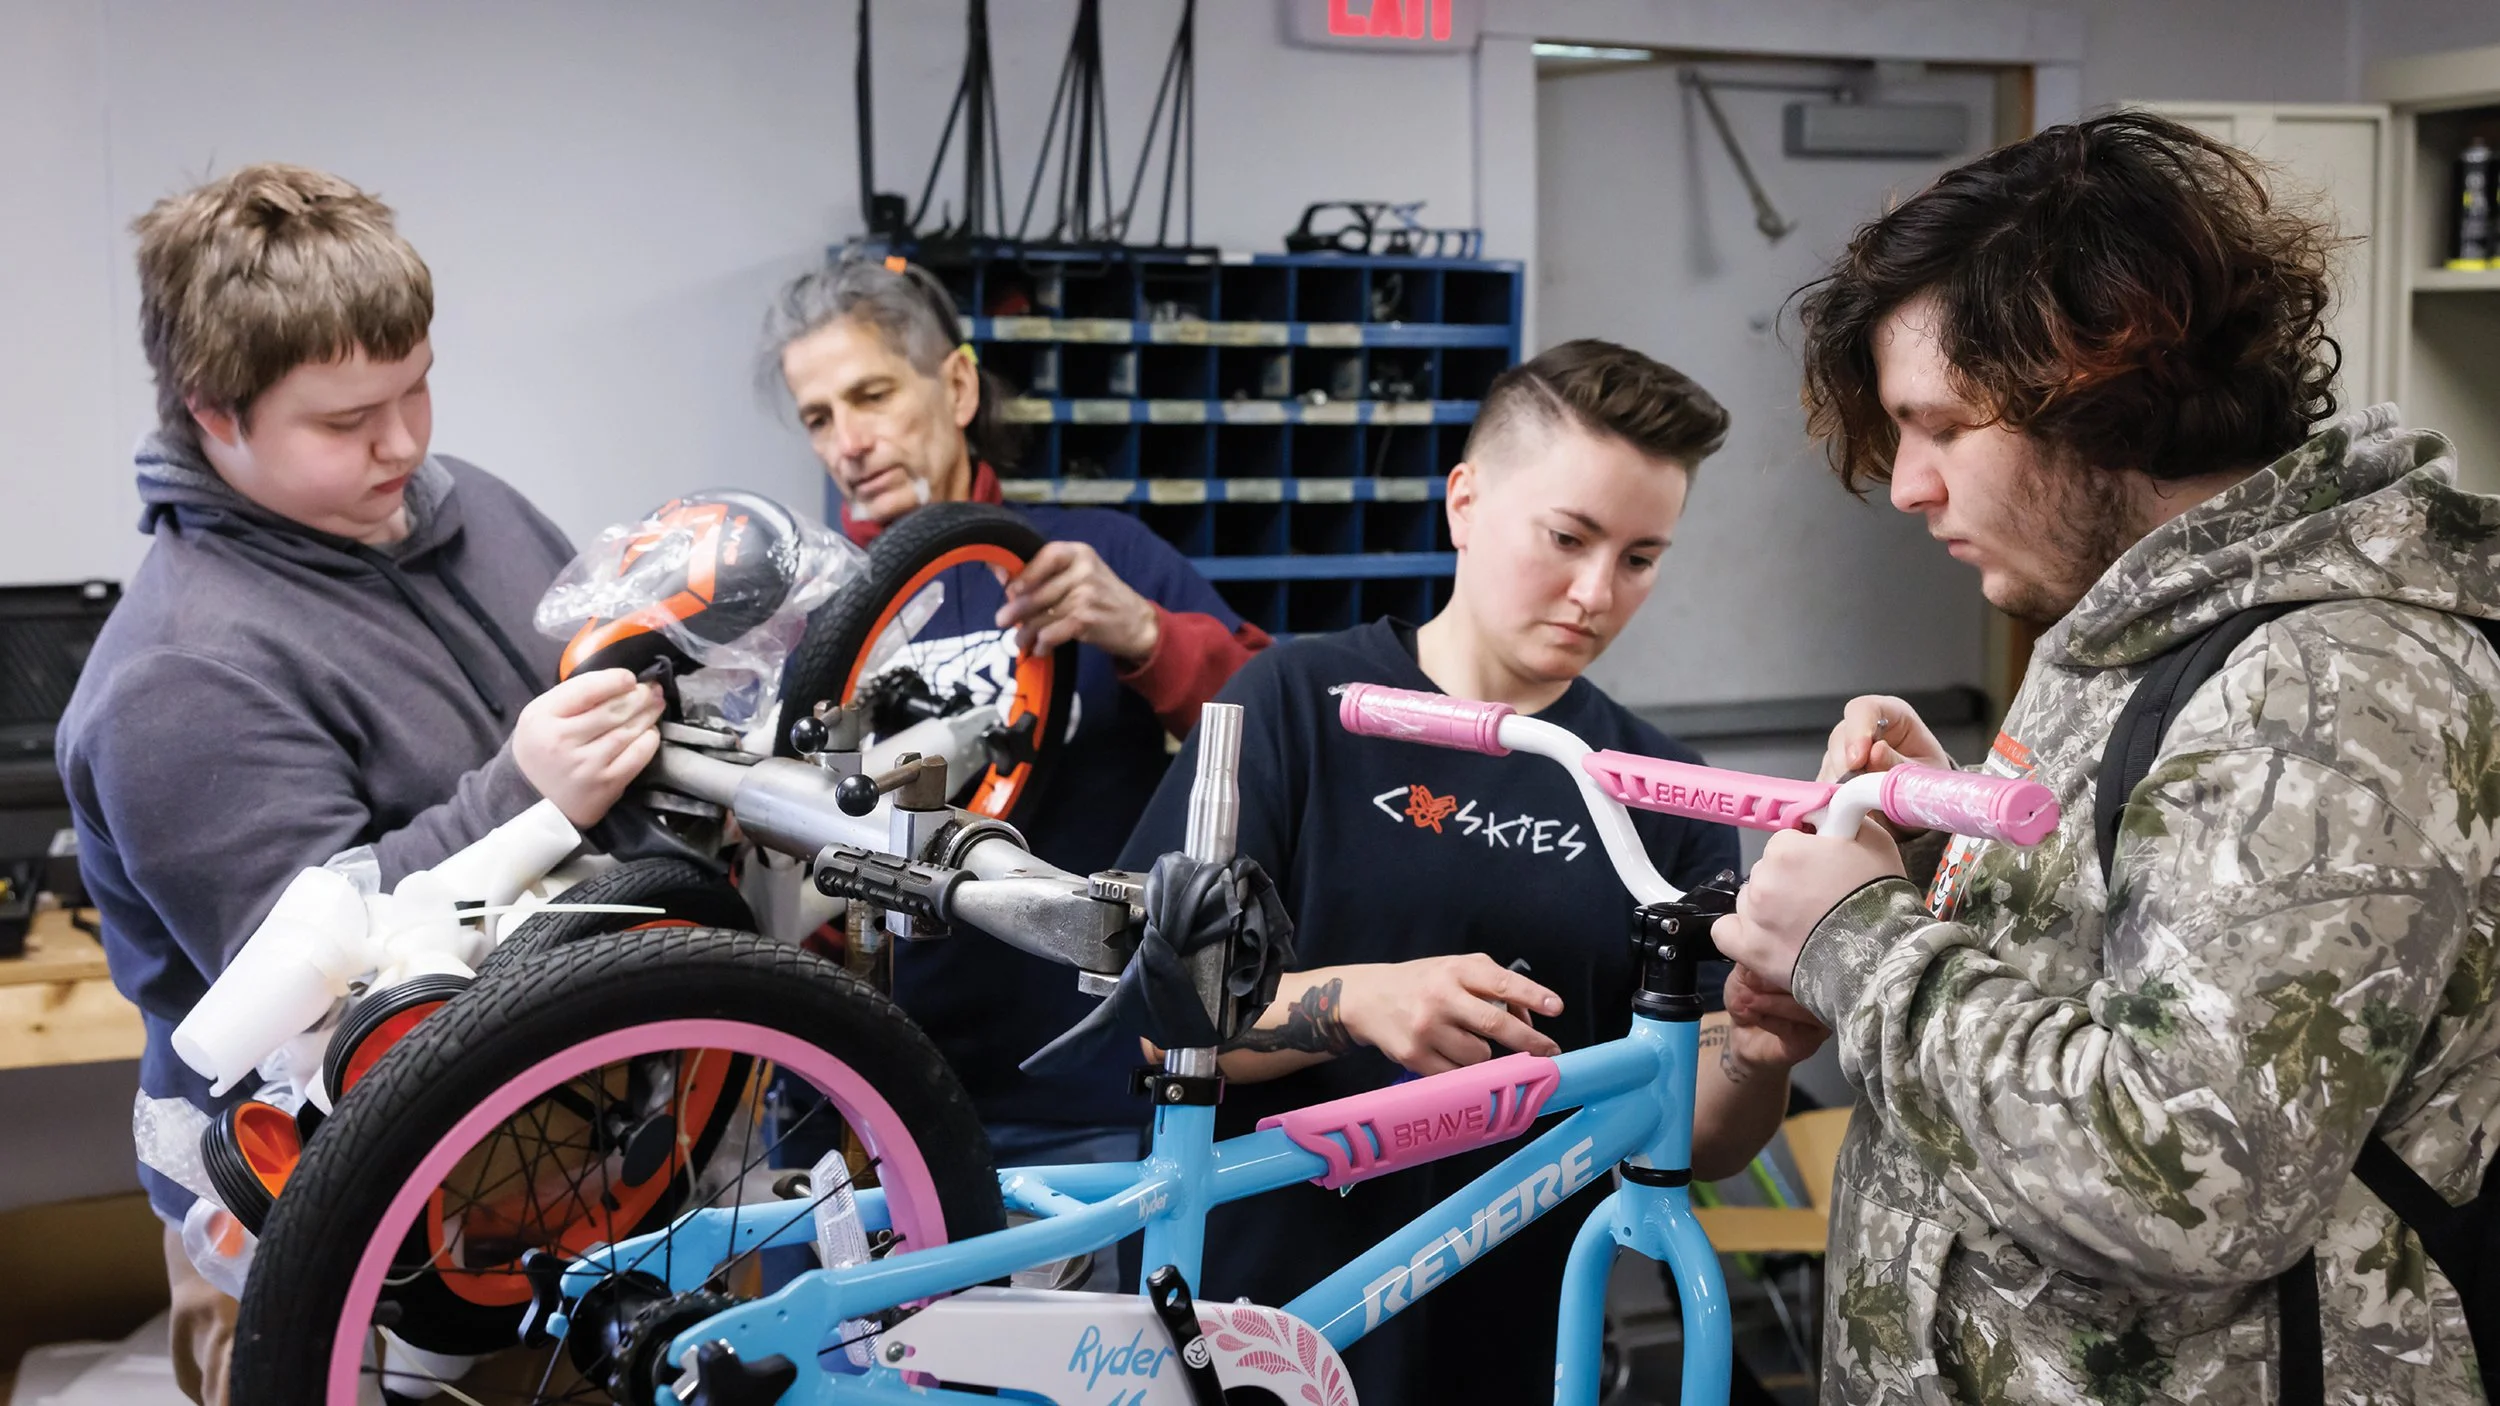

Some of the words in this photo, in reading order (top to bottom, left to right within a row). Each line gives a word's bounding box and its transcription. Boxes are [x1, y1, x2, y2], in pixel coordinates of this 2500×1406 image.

[1655, 781, 1736, 816] BRAVE
[1393, 1104, 1485, 1149] BRAVE
[1362, 1135, 1595, 1335] REVERE
[1067, 1324, 1174, 1391] Ryder
